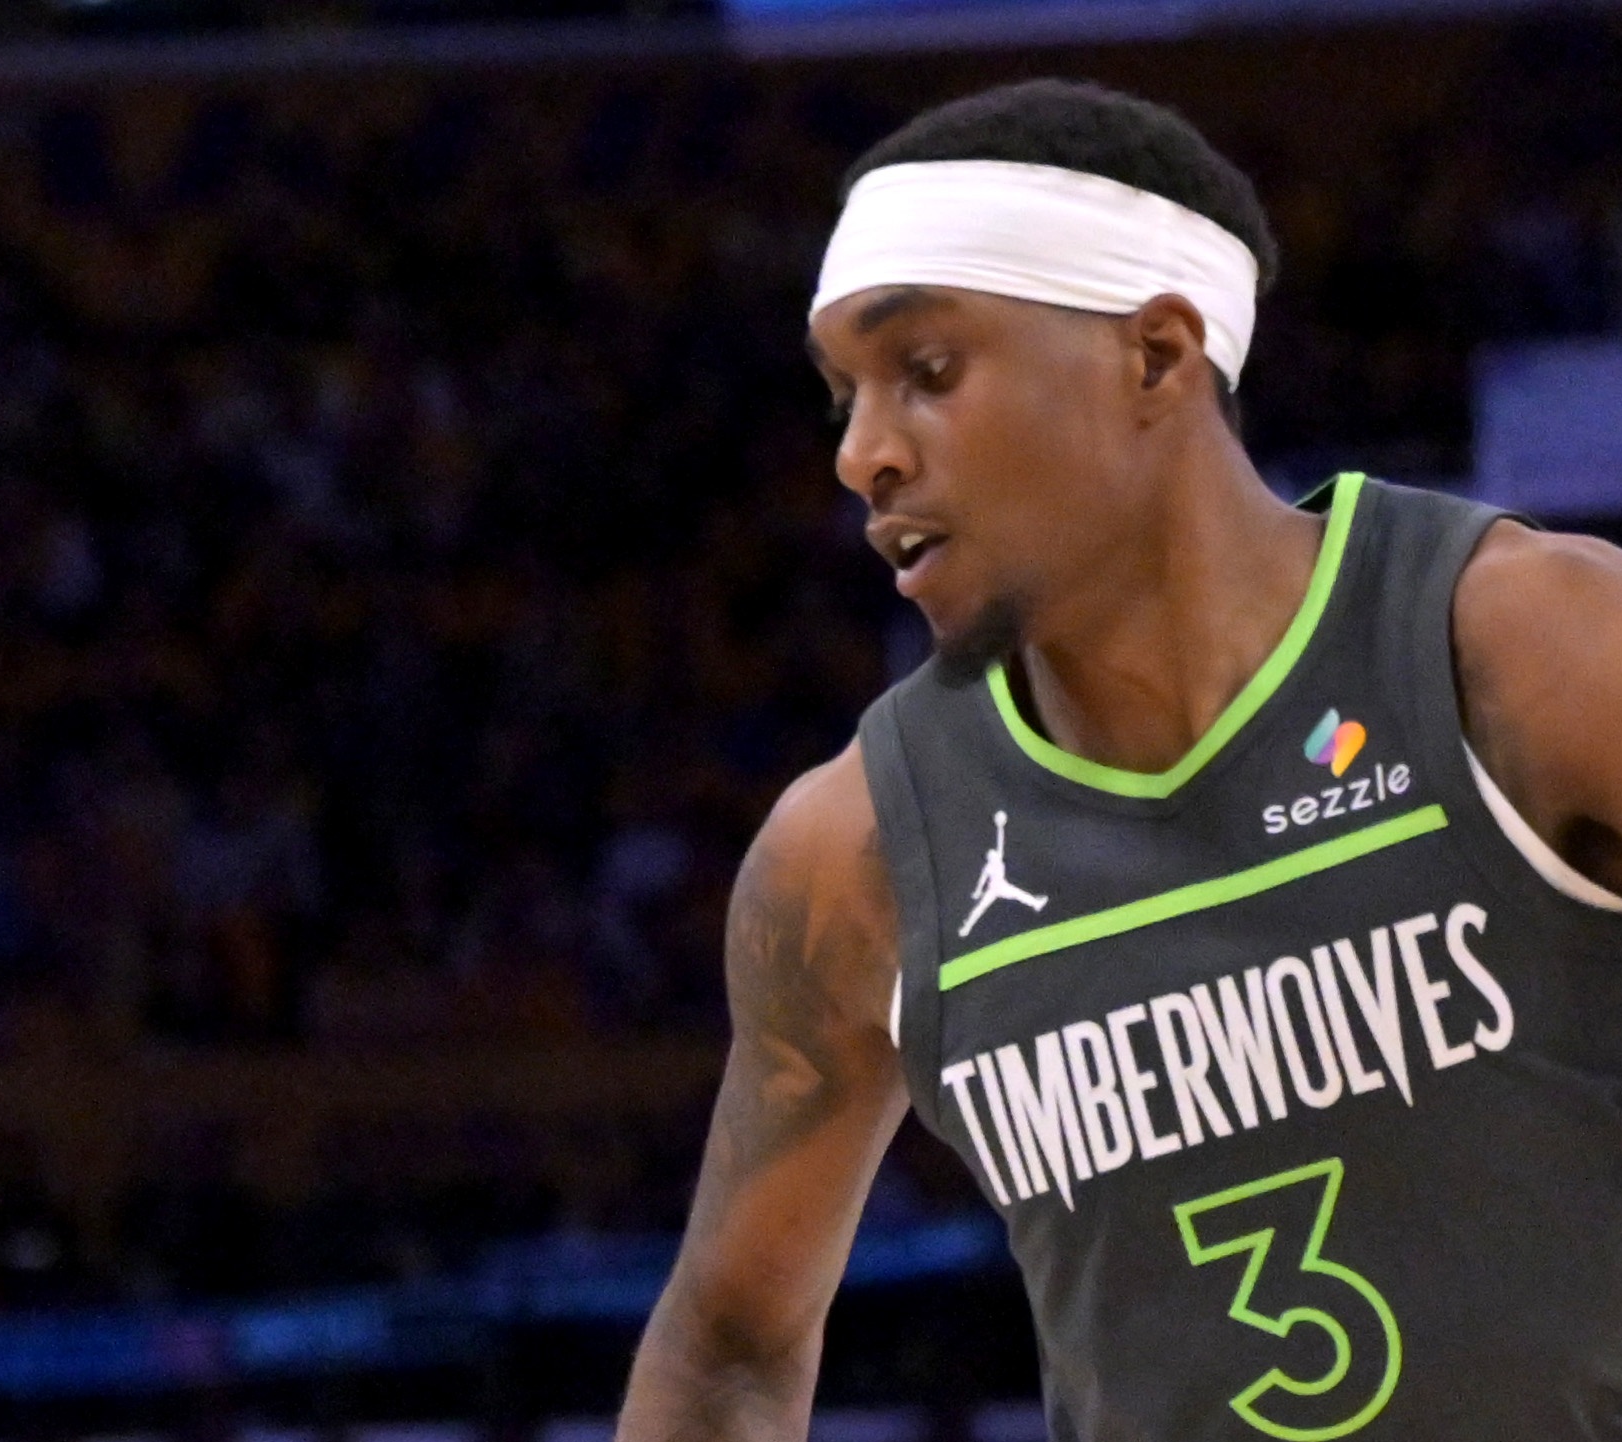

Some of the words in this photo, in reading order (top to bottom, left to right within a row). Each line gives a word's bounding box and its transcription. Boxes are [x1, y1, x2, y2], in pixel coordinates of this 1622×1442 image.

[1262, 762, 1411, 834] sezzle
[942, 902, 1516, 1212] TIMBERWOLVES
[1174, 1157, 1403, 1442] 3
